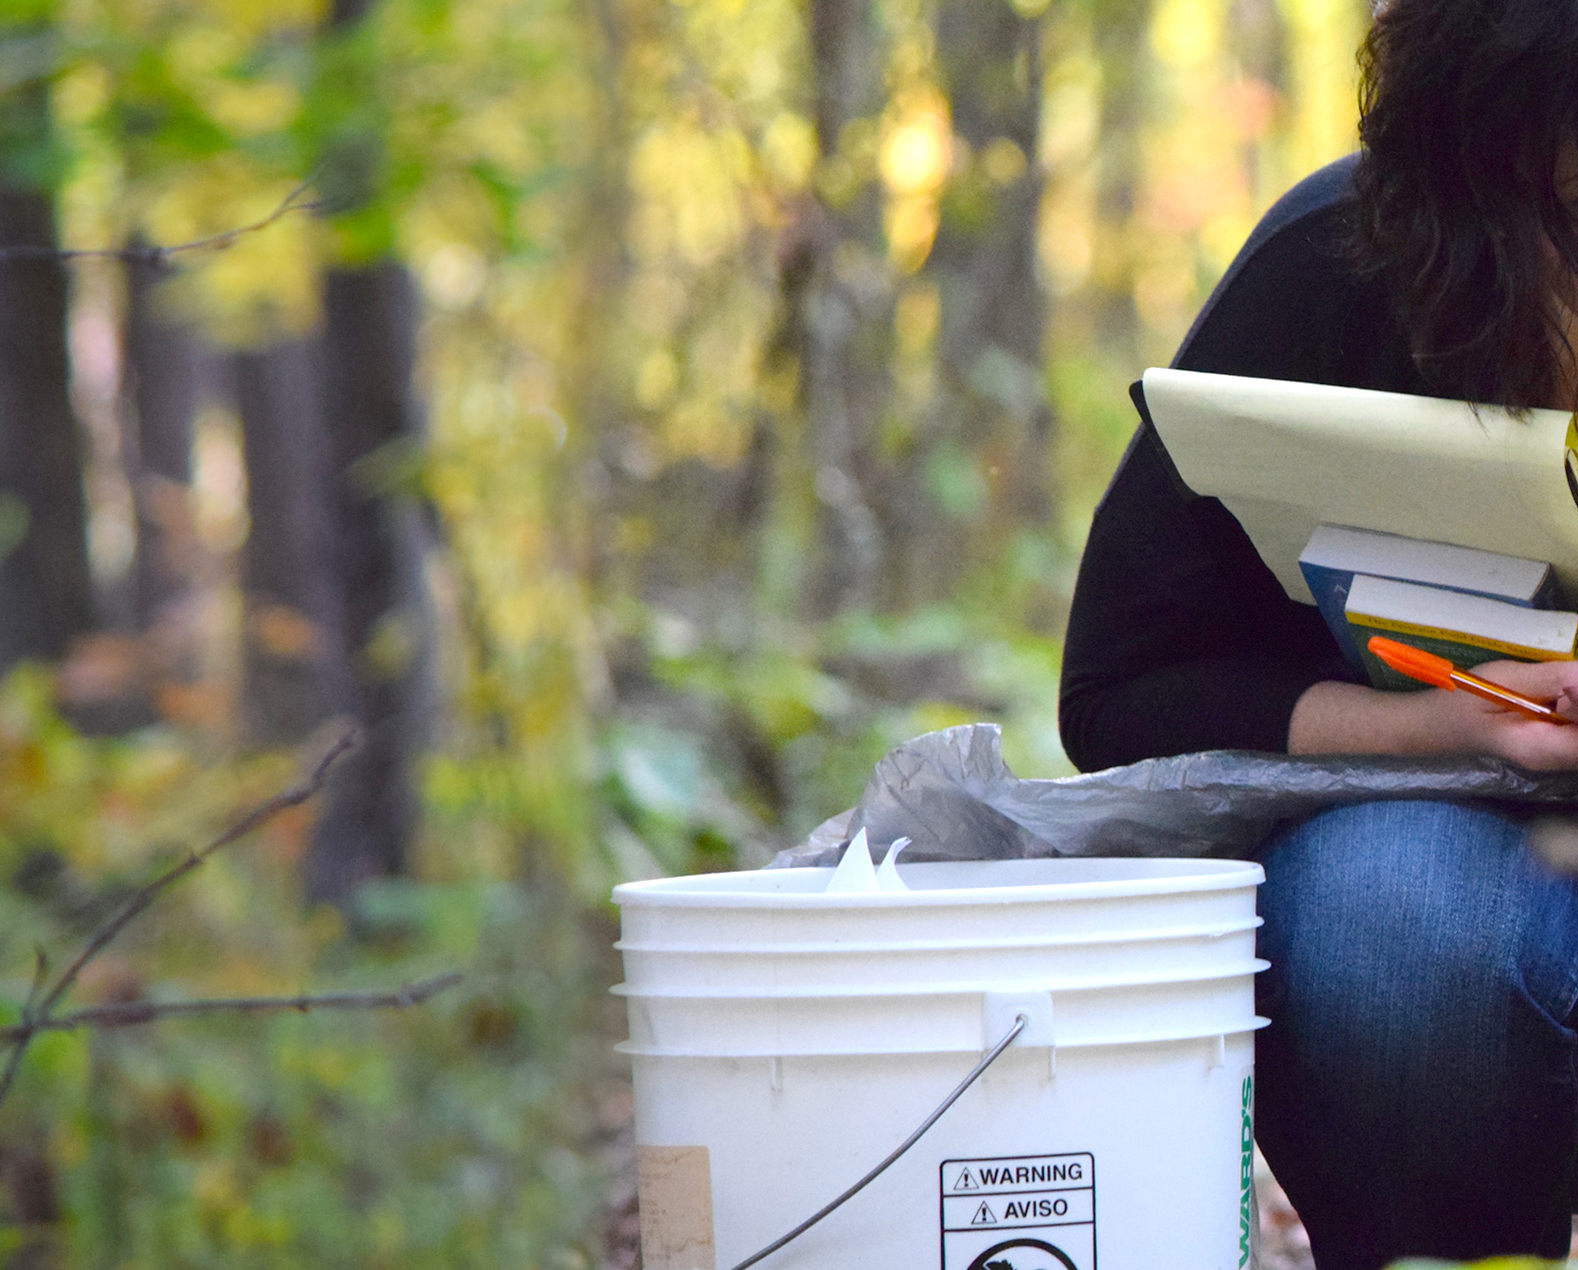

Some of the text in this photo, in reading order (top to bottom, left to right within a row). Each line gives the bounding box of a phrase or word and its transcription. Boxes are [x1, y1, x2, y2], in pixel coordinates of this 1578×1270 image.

[979, 1163, 1083, 1186] WARNING
[1238, 1076, 1253, 1270] WARD'S
[1003, 1198, 1069, 1220] AVISO
